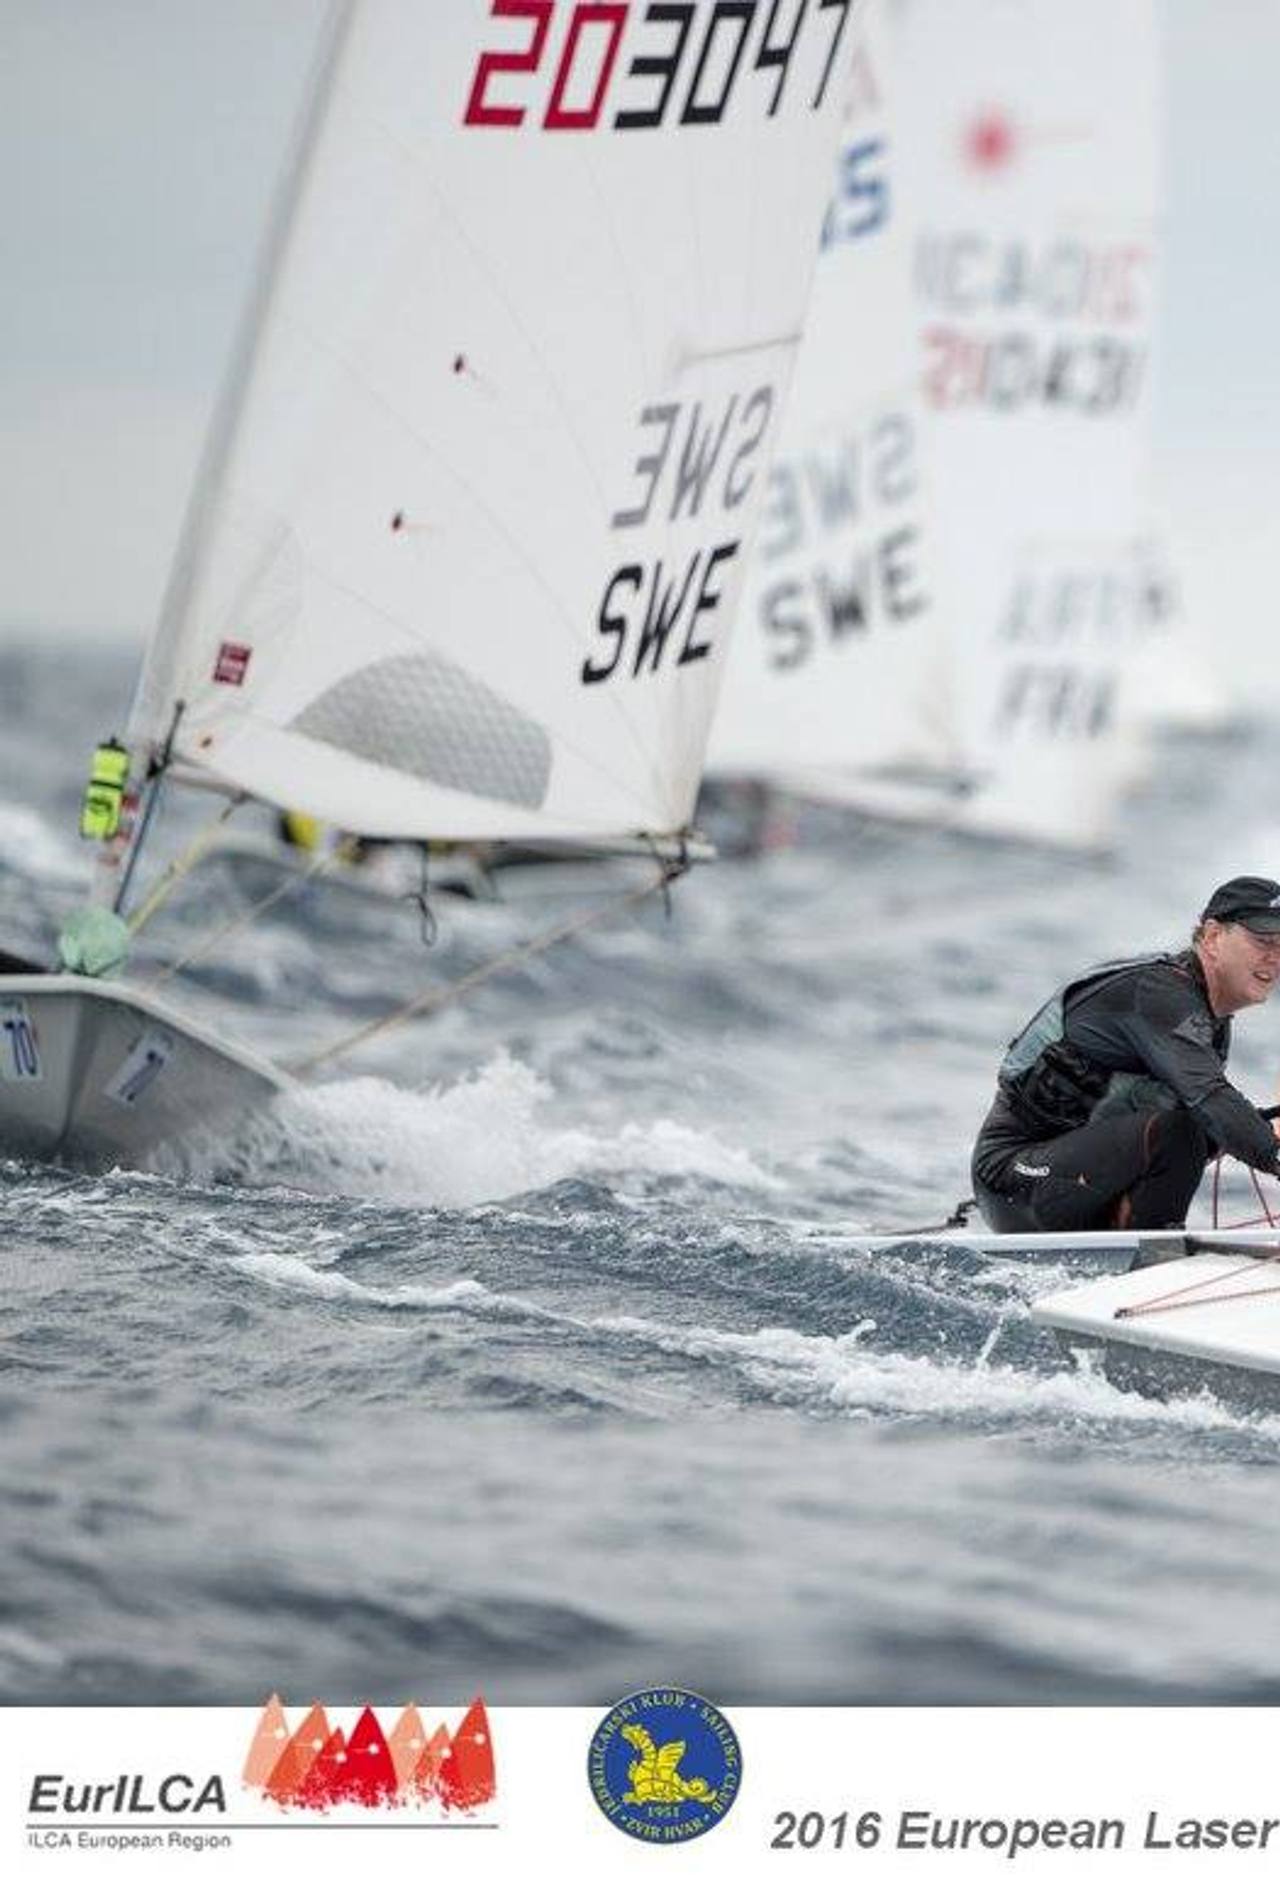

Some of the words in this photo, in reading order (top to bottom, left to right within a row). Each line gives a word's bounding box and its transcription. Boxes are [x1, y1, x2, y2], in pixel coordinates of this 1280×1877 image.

[463, 0, 850, 131] 203047
[581, 540, 741, 685] SWE
[760, 525, 930, 674] SWE
